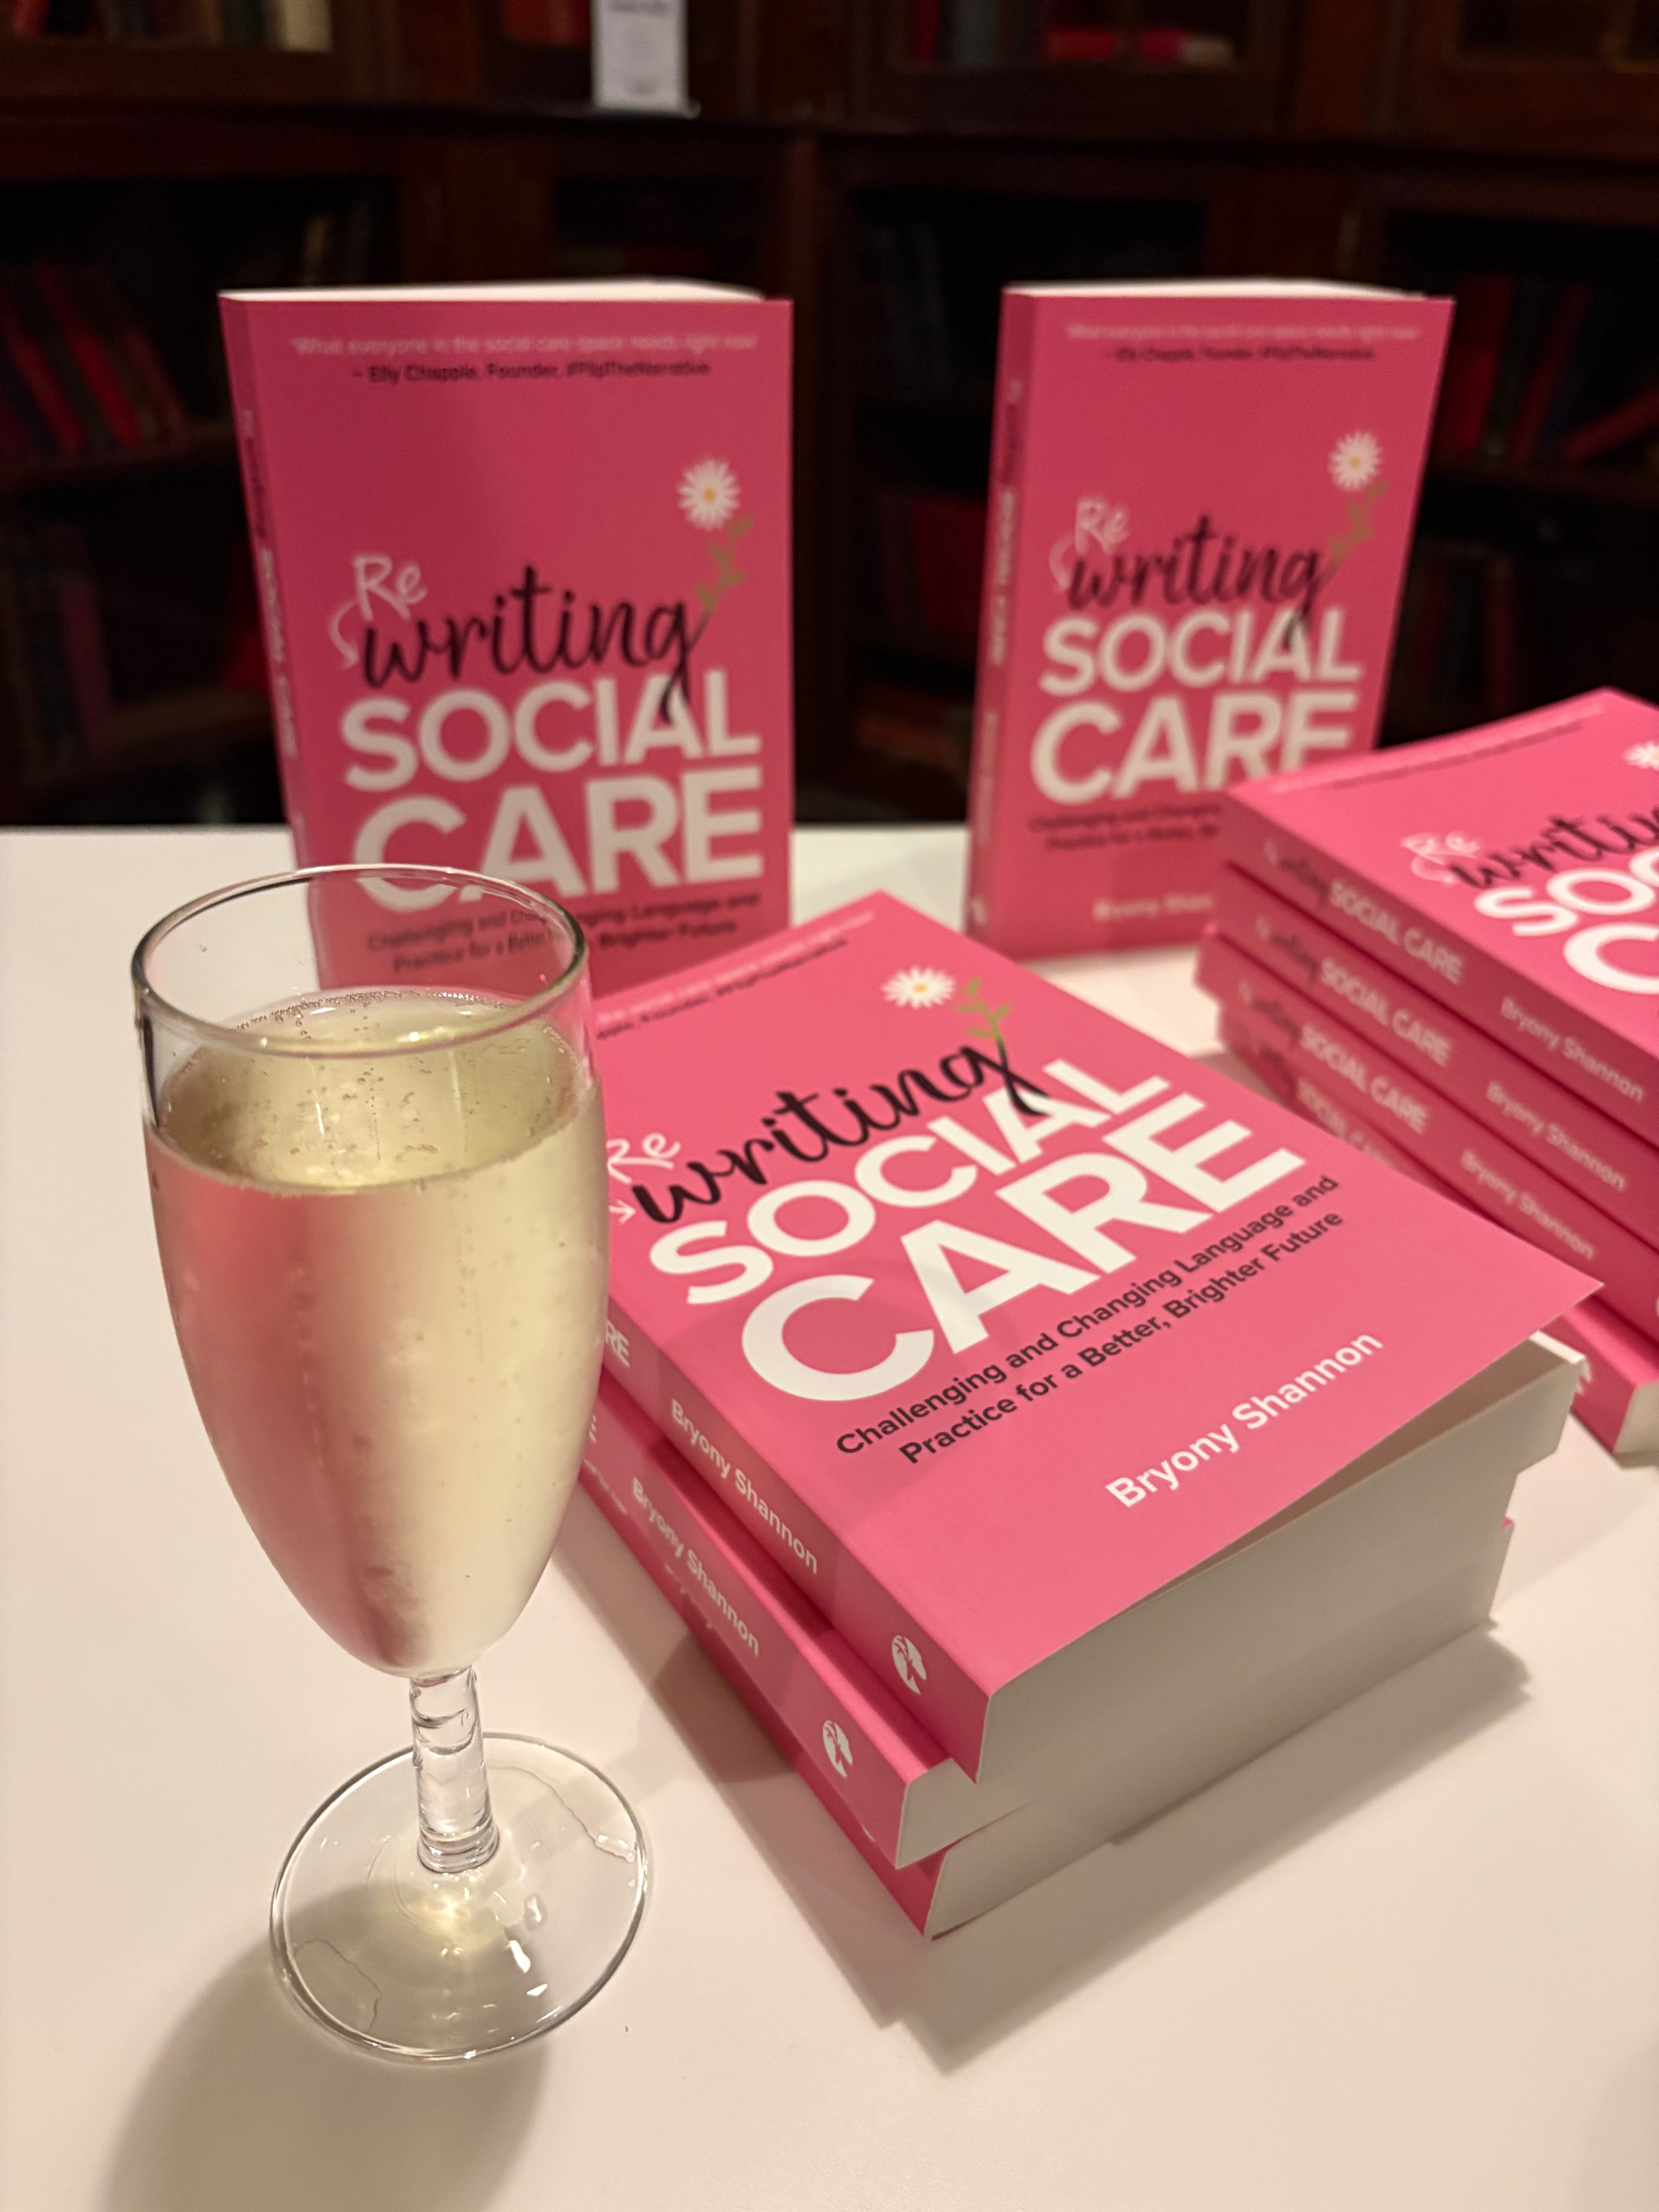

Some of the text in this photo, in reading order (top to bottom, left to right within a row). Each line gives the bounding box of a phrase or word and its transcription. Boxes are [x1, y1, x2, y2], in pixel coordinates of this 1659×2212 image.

[351, 551, 428, 622] Re
[362, 563, 691, 726] writing
[1039, 606, 1363, 696] SOCIAL
[1067, 514, 1321, 651] writing
[340, 668, 762, 792] SOCIAL
[351, 769, 763, 913] CARE
[631, 1044, 1050, 1224] writing
[649, 1058, 1171, 1304] SOCIAL
[741, 1093, 1306, 1401] CARE
[836, 1175, 1340, 1454] Challenging and Changing Language and
[898, 1212, 1344, 1464] Practice for a Better, Brighter Future
[1106, 1333, 1384, 1507] Bryony Shannon
[631, 1476, 684, 1558] Bryony
[687, 1549, 759, 1657] Shannon
[670, 1398, 730, 1480] Bryony
[734, 1469, 819, 1575] Shannon
